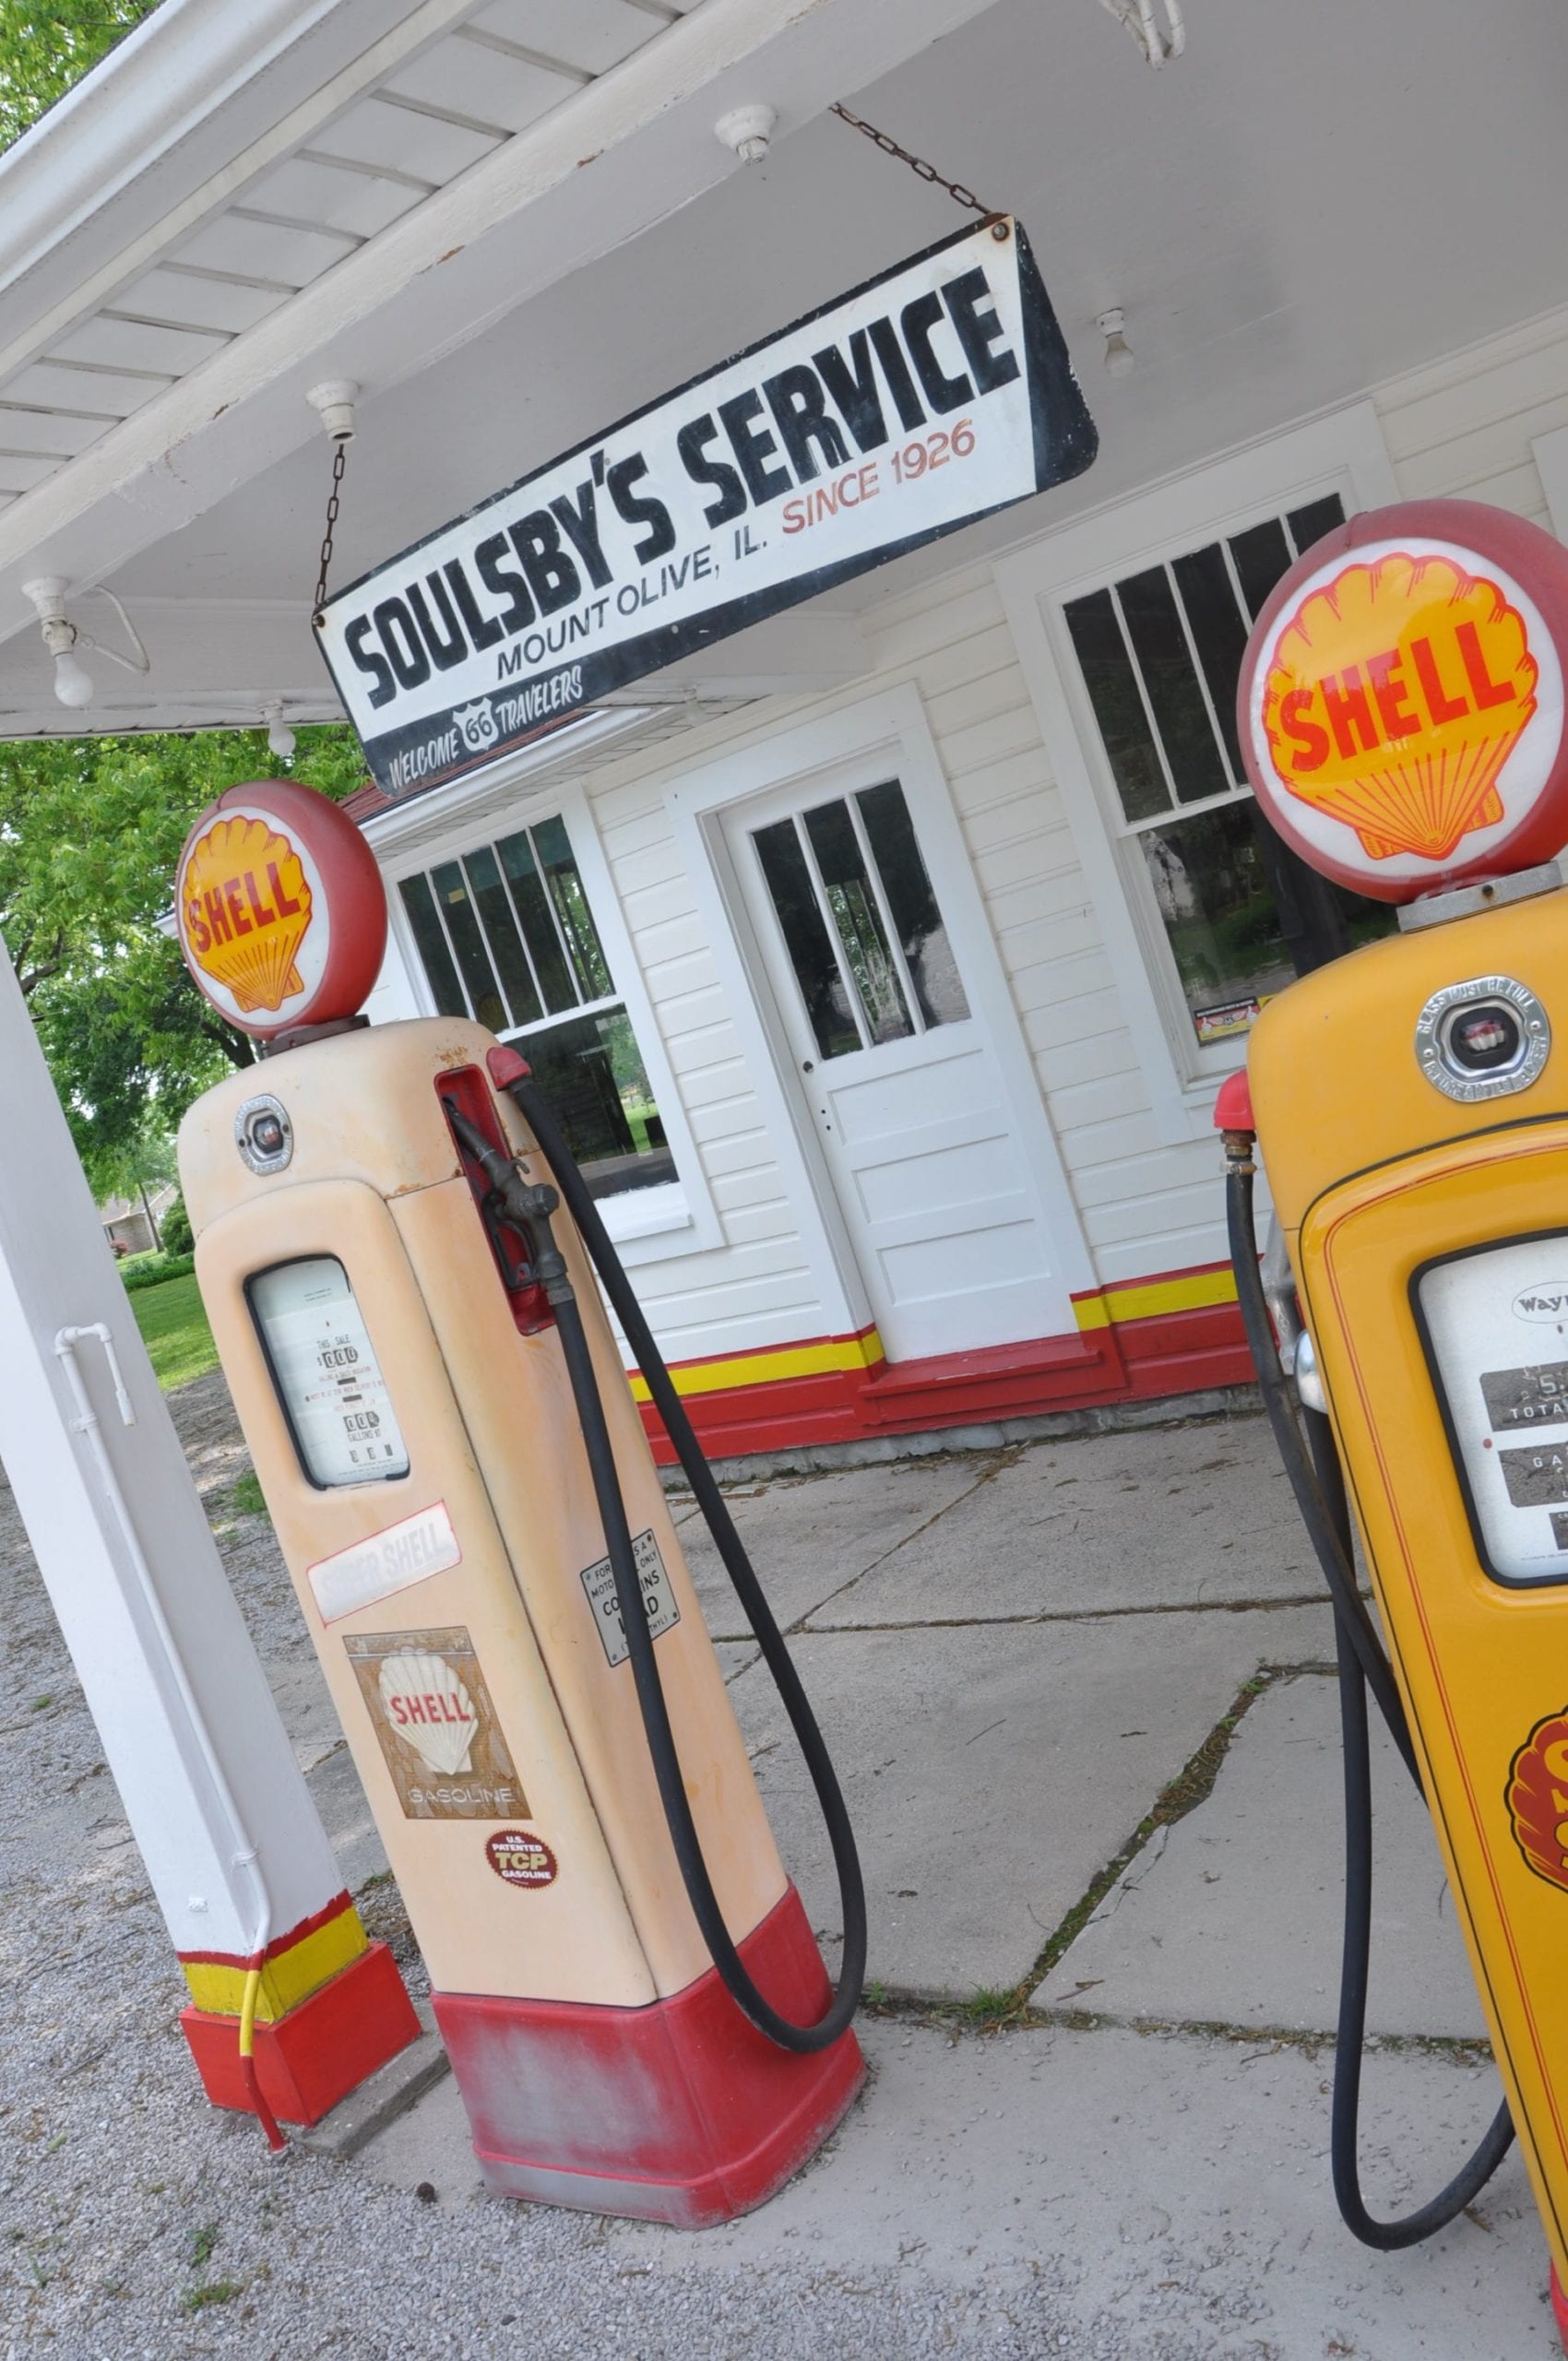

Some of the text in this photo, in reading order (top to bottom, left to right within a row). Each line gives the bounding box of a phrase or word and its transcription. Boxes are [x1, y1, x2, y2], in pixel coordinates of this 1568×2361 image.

[344, 266, 1021, 711] SOULSBY'S SERVICE
[496, 418, 977, 681] MOUNT OLIVE, IL. SINCE 1926
[1279, 621, 1517, 772] SHELL
[389, 665, 583, 789] WELCOME 66 TRAVELERS
[190, 861, 301, 953] SHELL
[1417, 994, 1446, 1035] GLASS
[1487, 978, 1503, 993] BE
[1505, 980, 1535, 1014] FULL
[383, 1523, 449, 1578] SHELL
[594, 1564, 612, 1581] FOR
[591, 1551, 657, 1599] MOTO ONLY
[389, 1691, 471, 1725] SHELL
[408, 1787, 516, 1804] GASOLINE
[492, 1843, 542, 1852] PATENTED
[494, 1852, 548, 1870] TCP
[505, 1835, 525, 1844] U.S.
[501, 1869, 552, 1880] GASOLINE
